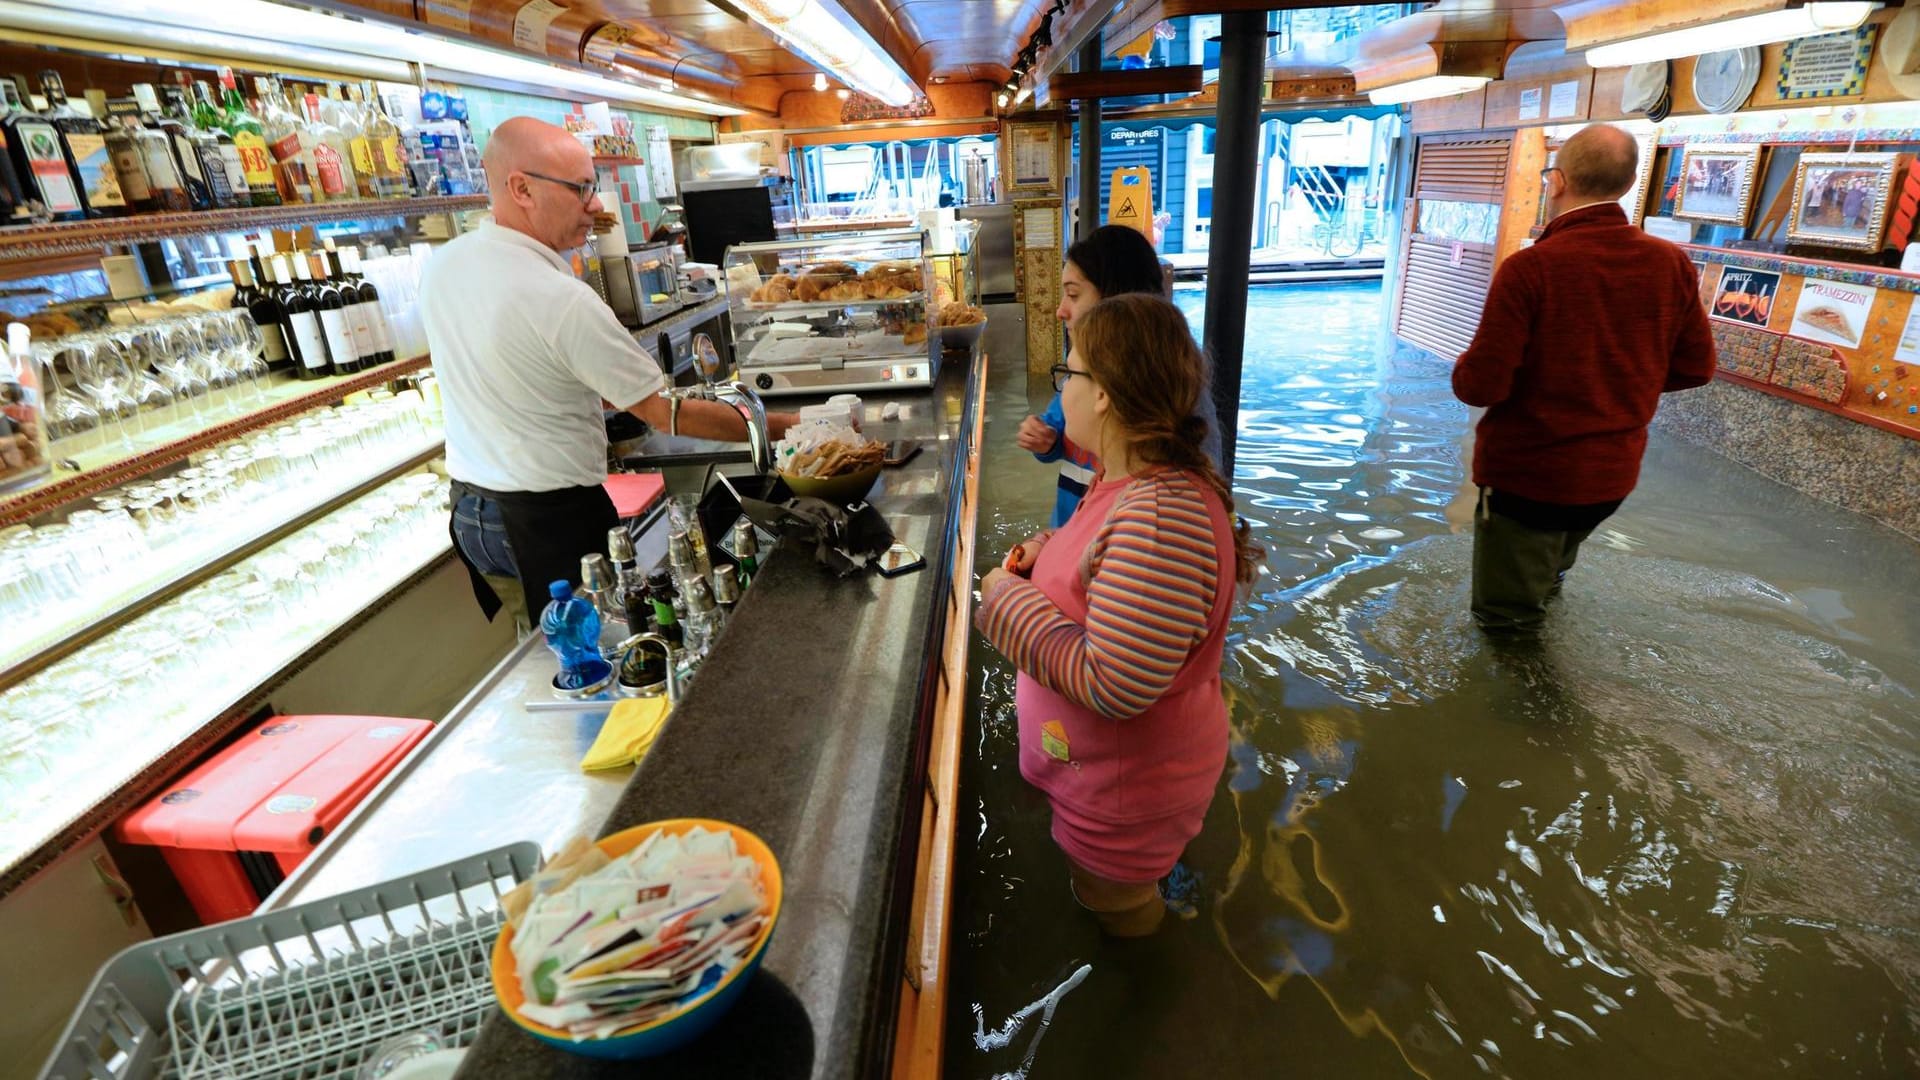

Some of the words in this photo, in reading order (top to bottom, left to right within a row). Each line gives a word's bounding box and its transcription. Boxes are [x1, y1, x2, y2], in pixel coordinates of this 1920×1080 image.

[1111, 130, 1159, 140] DEPARTURES
[1726, 272, 1753, 282] SPRITZ
[1812, 284, 1868, 306] TRAMEZZINI
